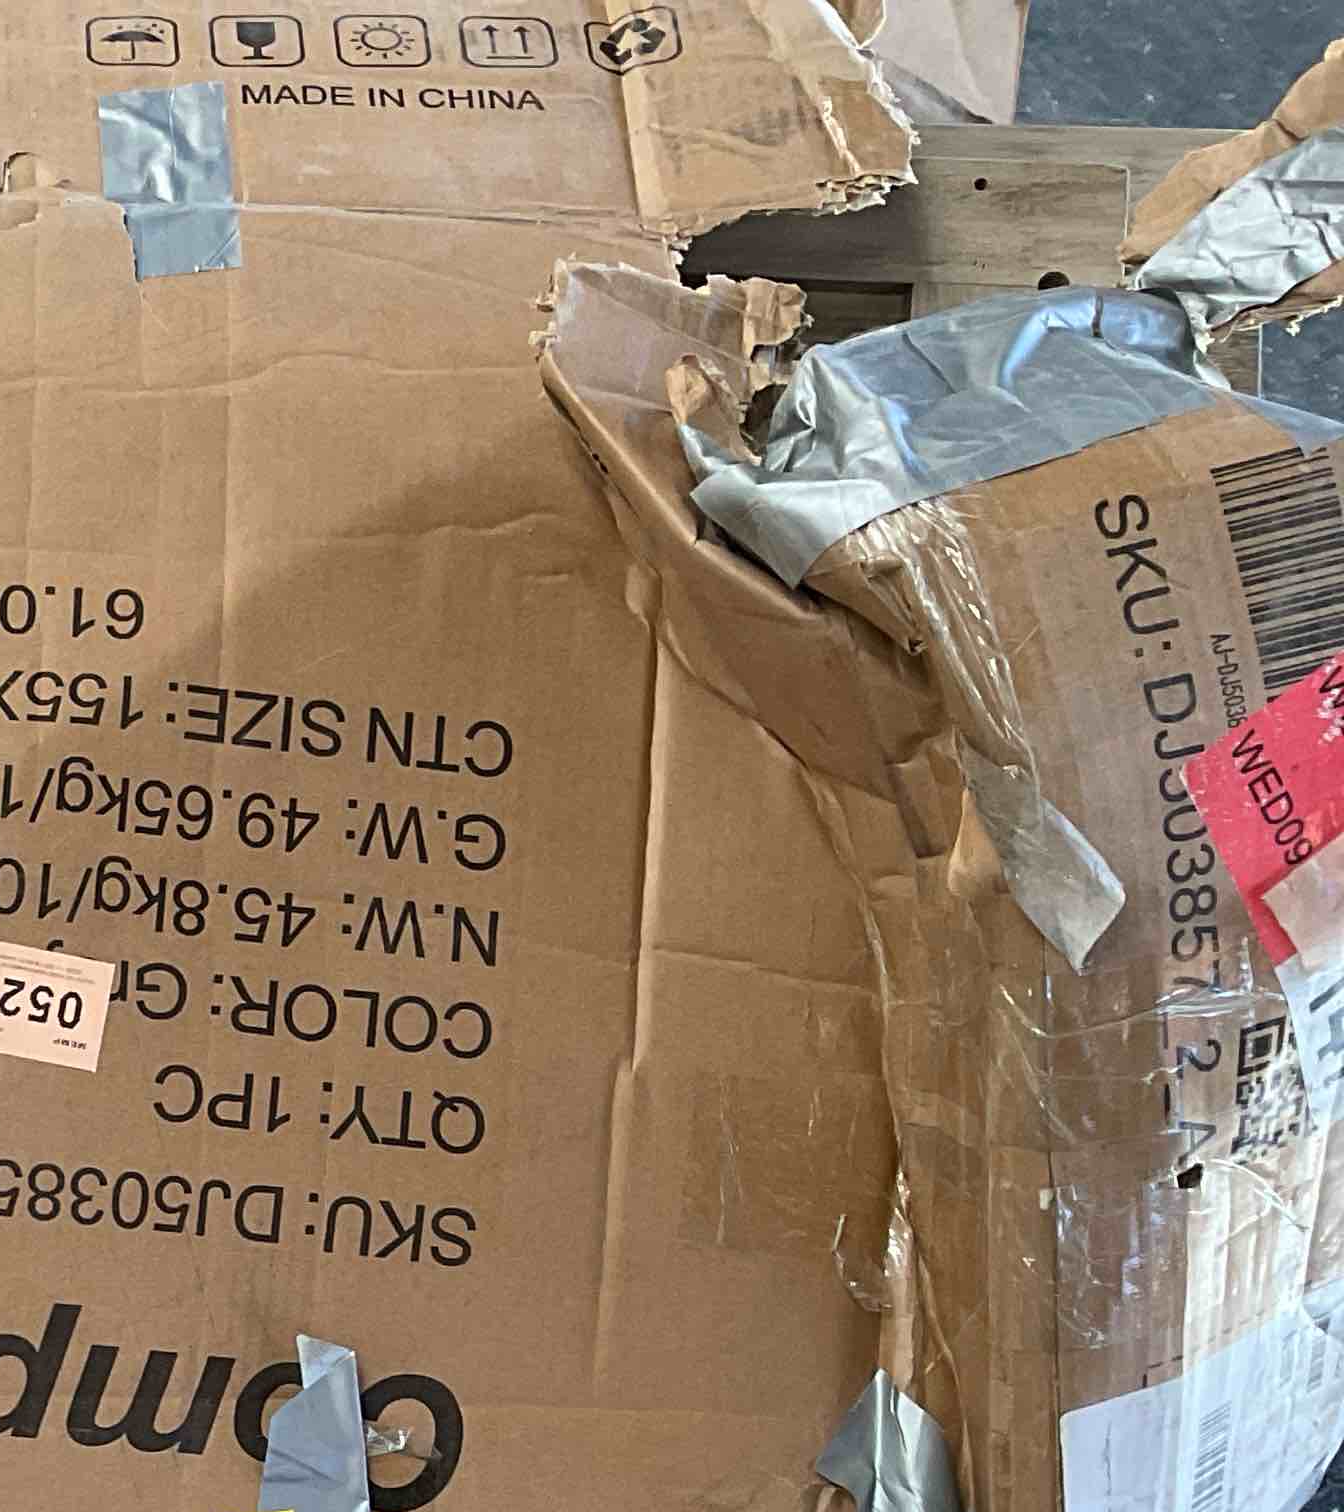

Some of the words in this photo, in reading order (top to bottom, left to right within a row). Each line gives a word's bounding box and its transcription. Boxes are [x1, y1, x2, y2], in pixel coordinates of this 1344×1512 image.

[241, 84, 355, 106] MADE
[368, 87, 405, 107] IN
[419, 88, 545, 111] CHINA
[1095, 494, 1180, 658] SKU:
[166, 682, 344, 757] SIZE:
[366, 706, 513, 778] CTN
[1231, 729, 1313, 865] WED09
[345, 798, 506, 872] G.W:
[341, 893, 499, 967] N.W:
[210, 973, 494, 1060] COLOR:
[153, 1064, 291, 1135] 1PC
[319, 1080, 487, 1156] QTY:
[304, 1192, 477, 1267] SKU:
